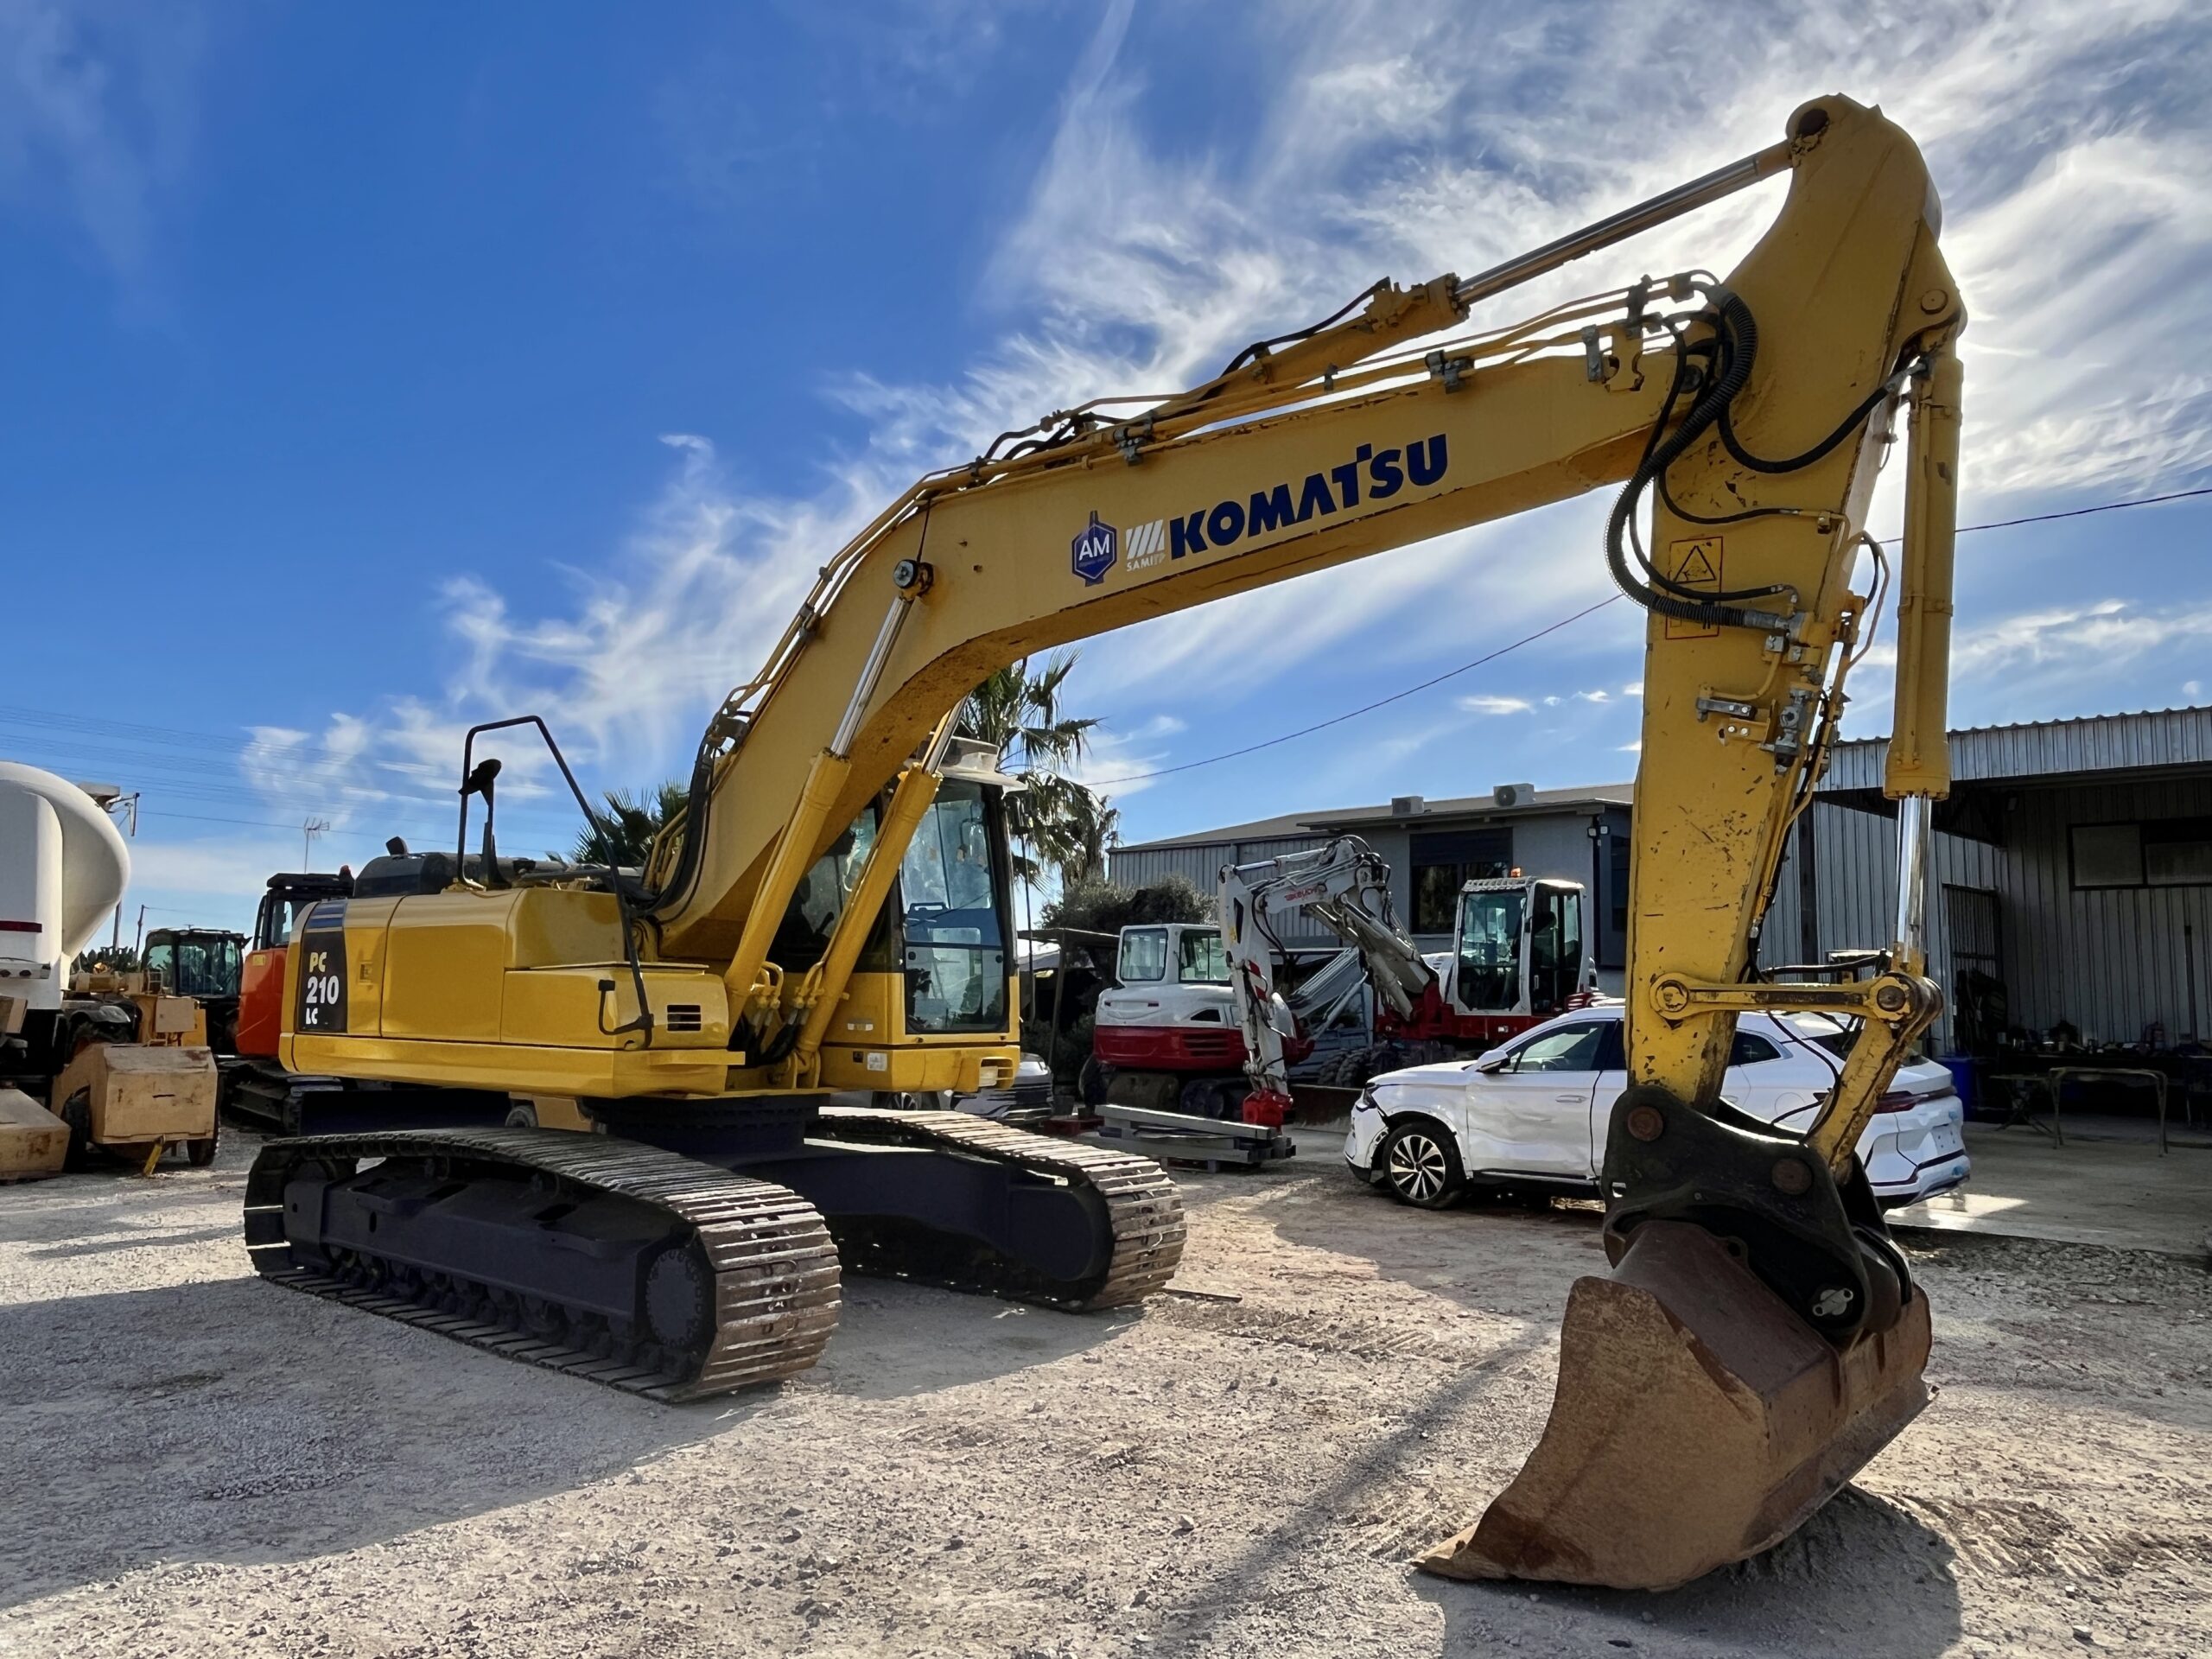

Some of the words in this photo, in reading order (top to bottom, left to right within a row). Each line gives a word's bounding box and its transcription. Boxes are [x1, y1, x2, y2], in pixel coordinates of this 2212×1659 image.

[1170, 434, 1448, 560] KOMATSU
[1079, 534, 1109, 561] AM
[309, 951, 327, 973] PC
[306, 976, 340, 1005] 210
[305, 1007, 318, 1025] LC
